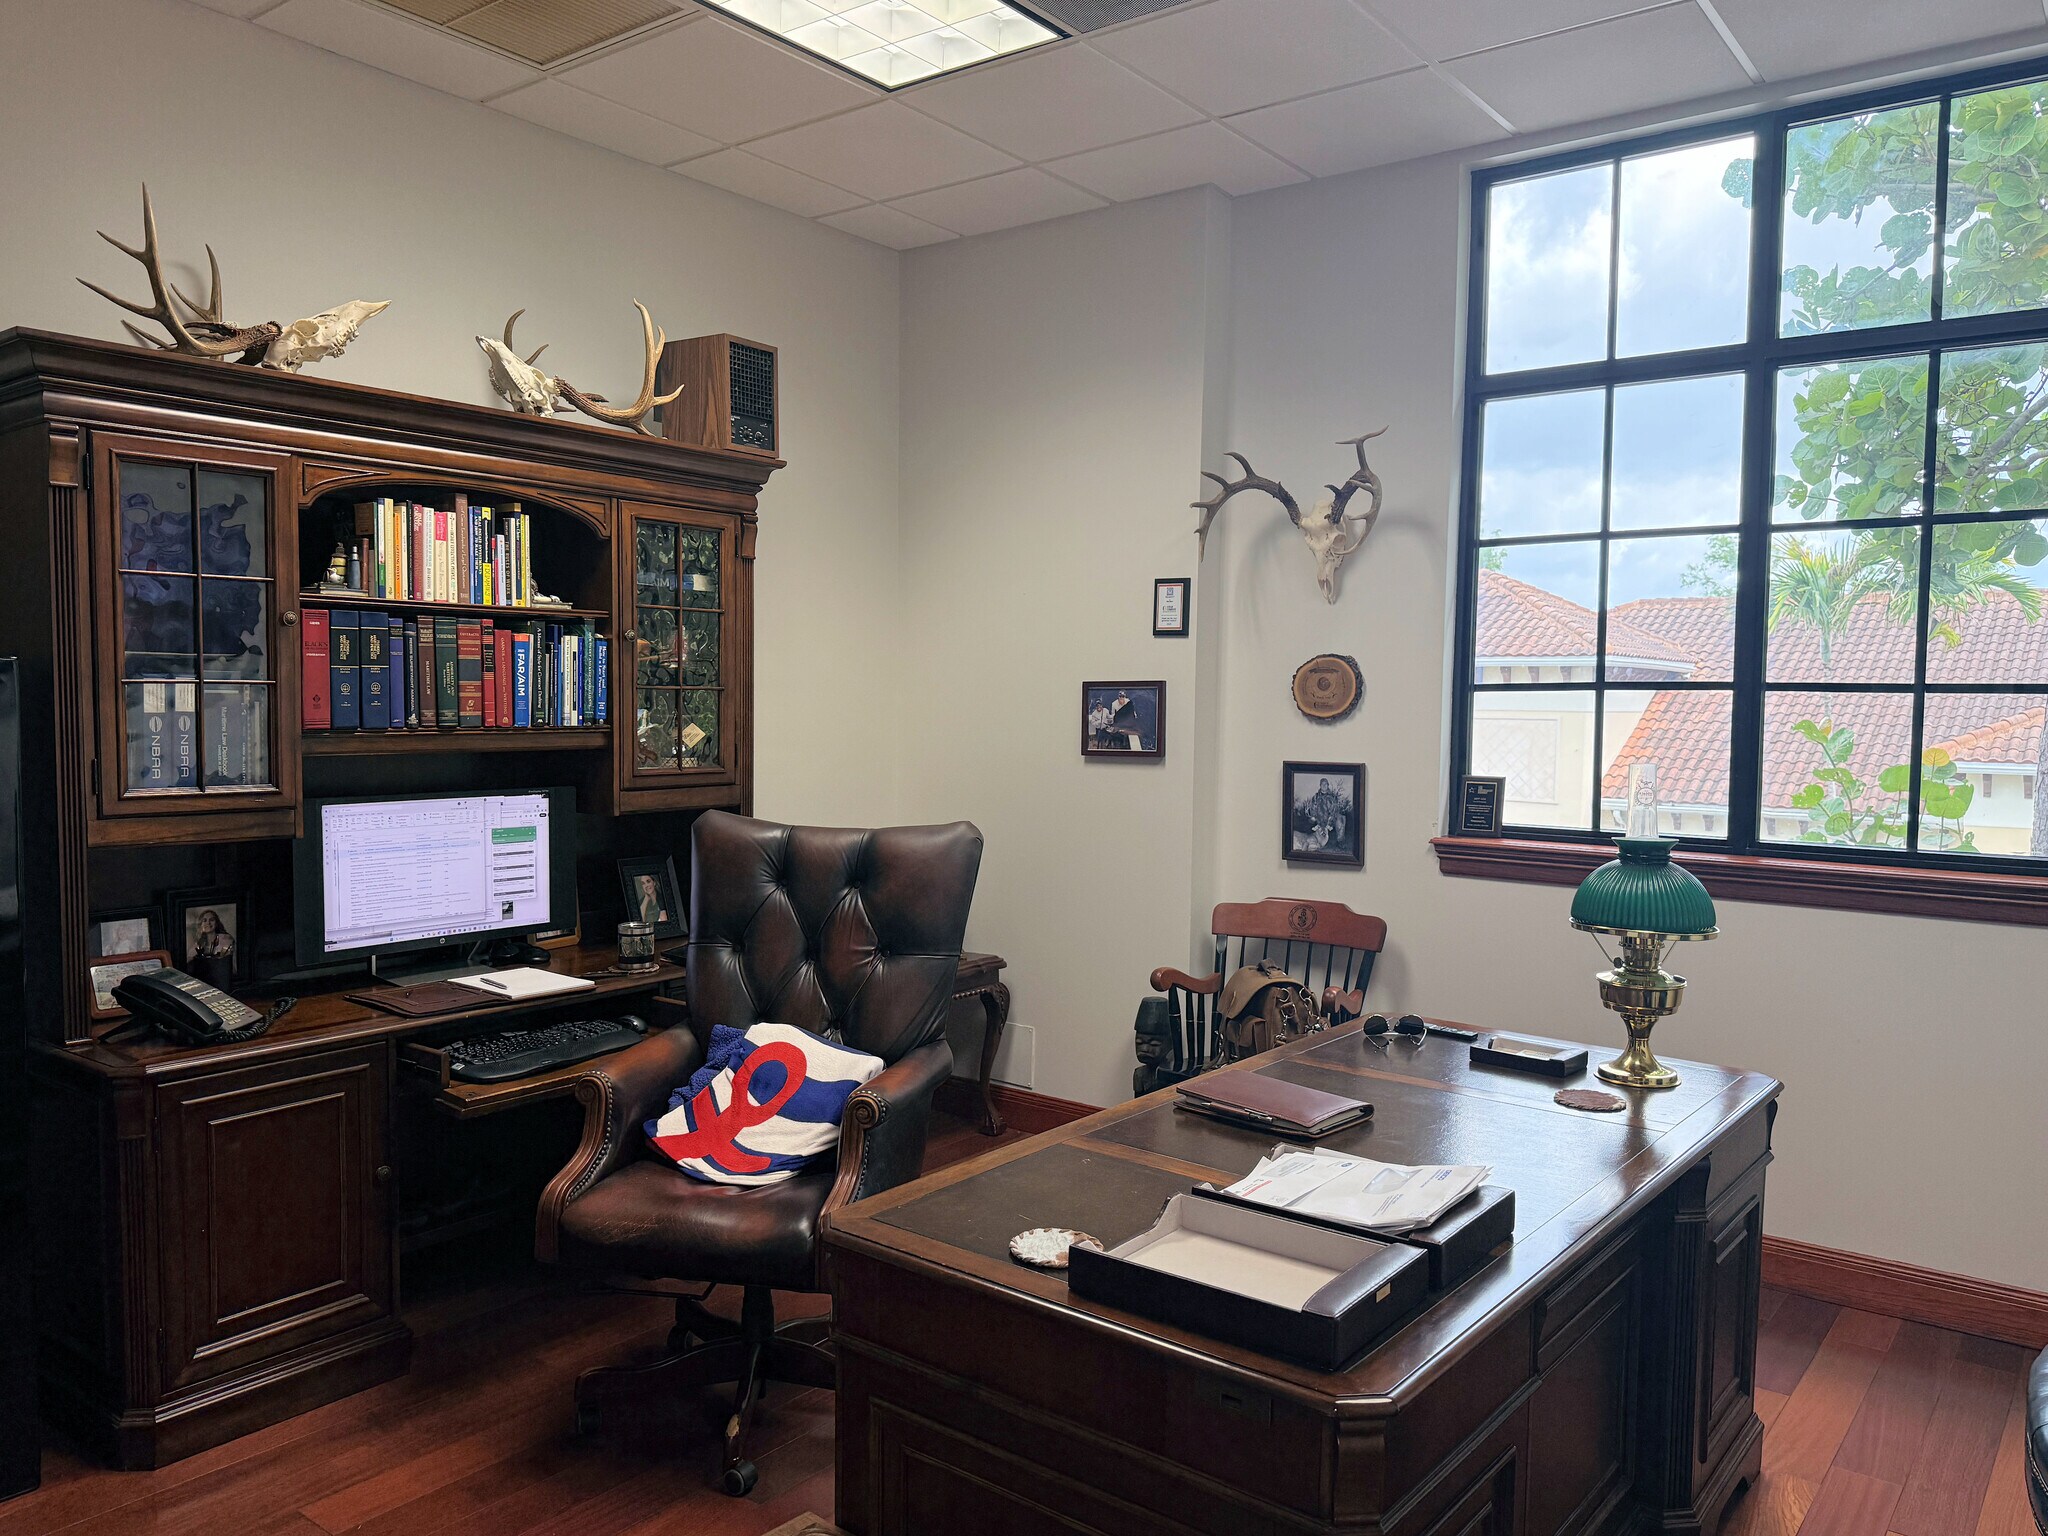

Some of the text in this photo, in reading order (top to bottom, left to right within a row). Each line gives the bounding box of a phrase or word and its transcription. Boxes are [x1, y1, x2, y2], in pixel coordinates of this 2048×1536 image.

[517, 653, 526, 696] FAR/AIM
[151, 735, 161, 779] NBAA
[180, 734, 190, 778] NBAA
